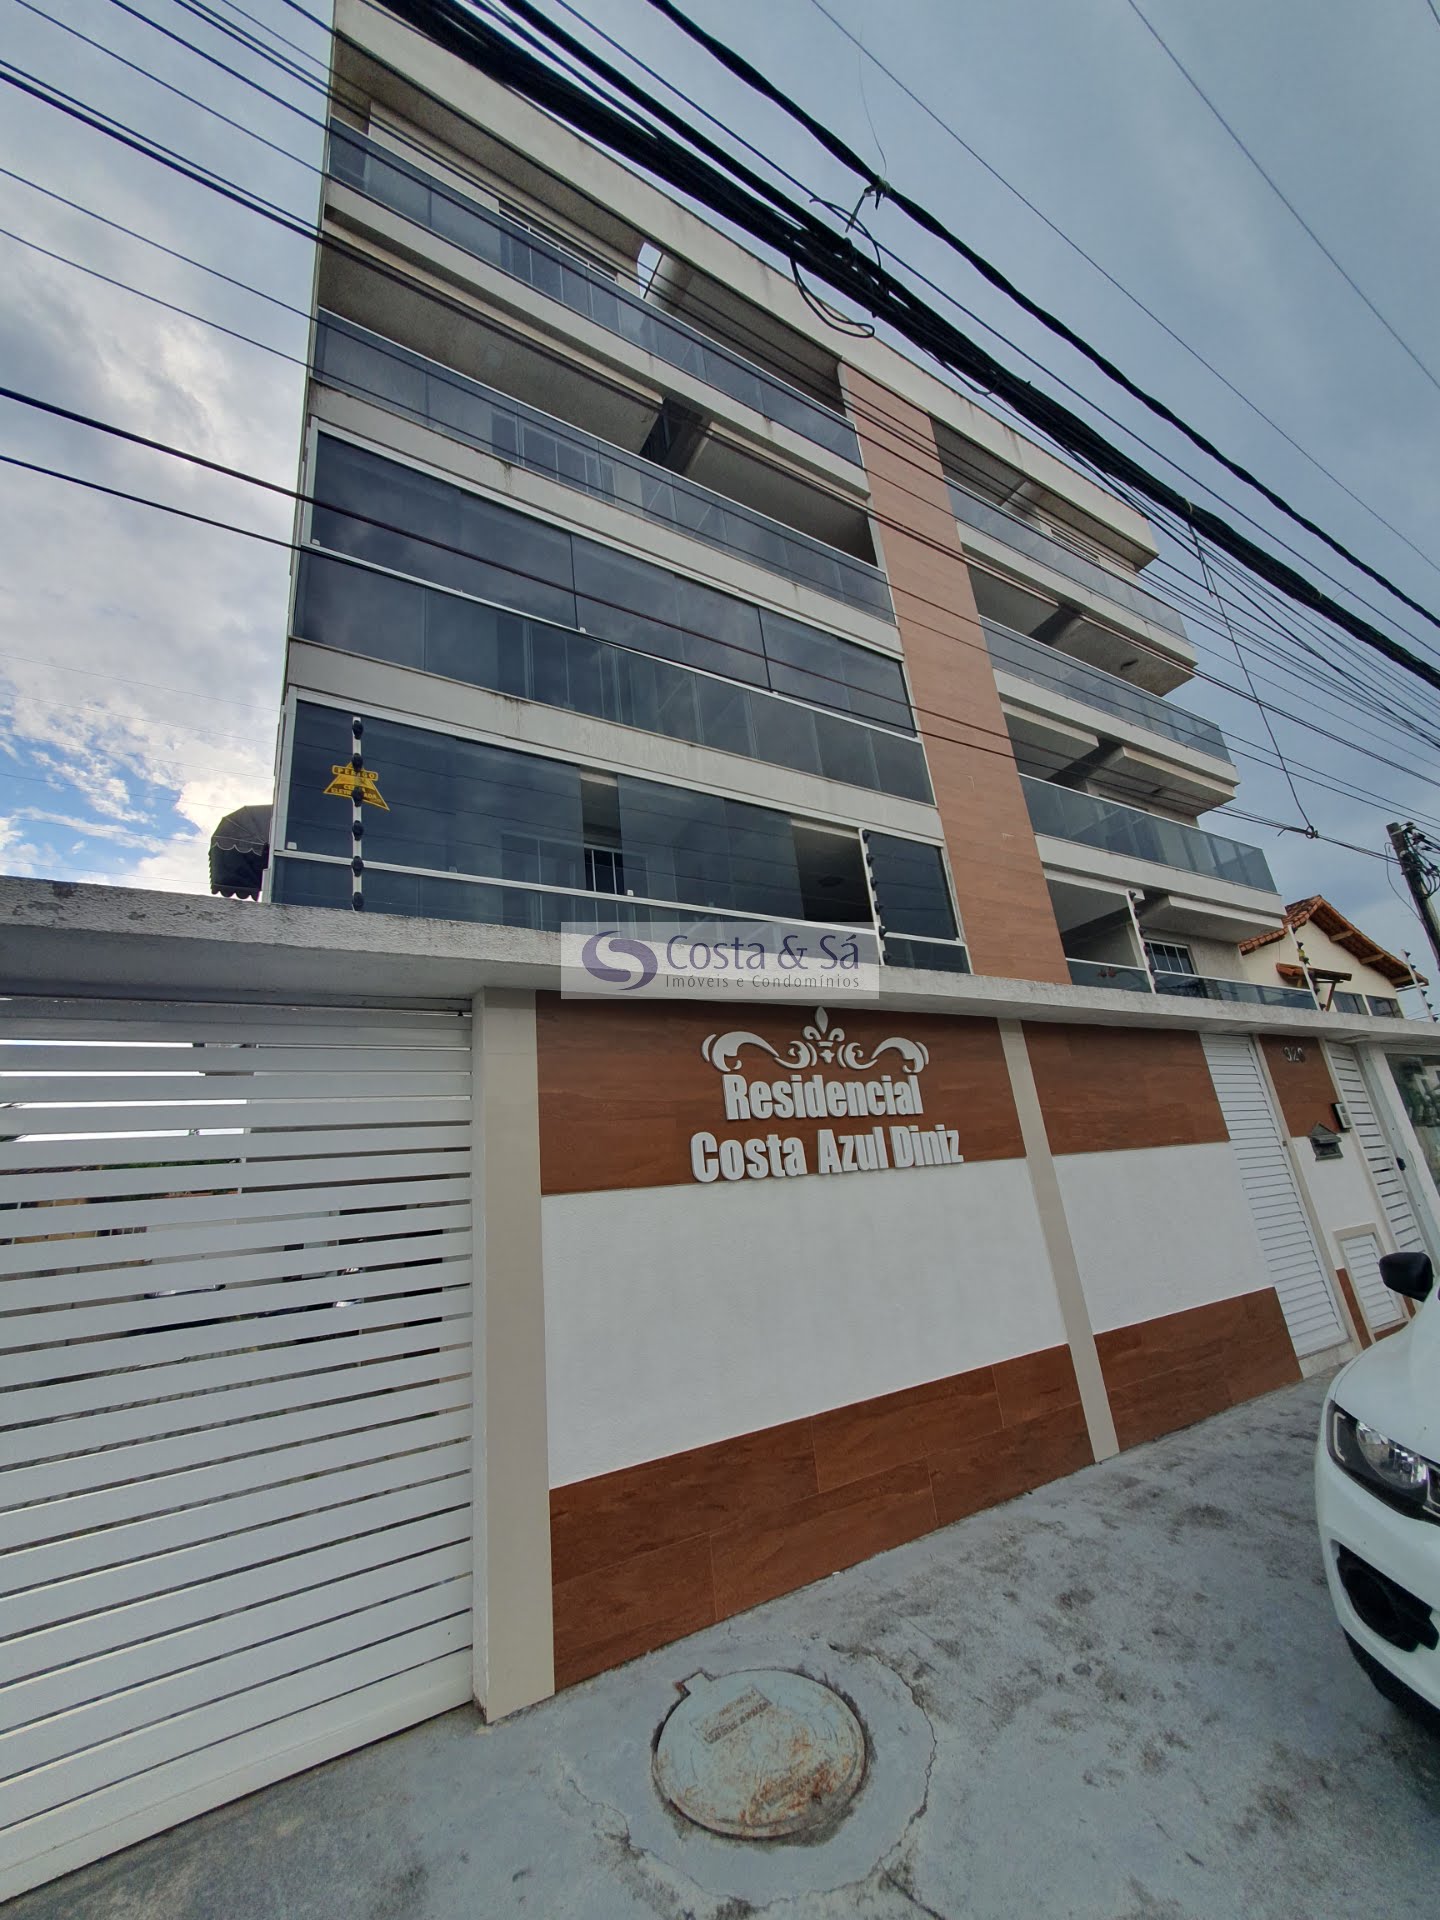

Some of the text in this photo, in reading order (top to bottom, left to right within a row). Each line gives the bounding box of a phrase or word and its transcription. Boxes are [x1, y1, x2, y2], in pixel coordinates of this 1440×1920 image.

[337, 768, 376, 779] PERIGO
[722, 1074, 924, 1120] Residencial
[690, 1123, 964, 1183] Costa Azul Diniz
